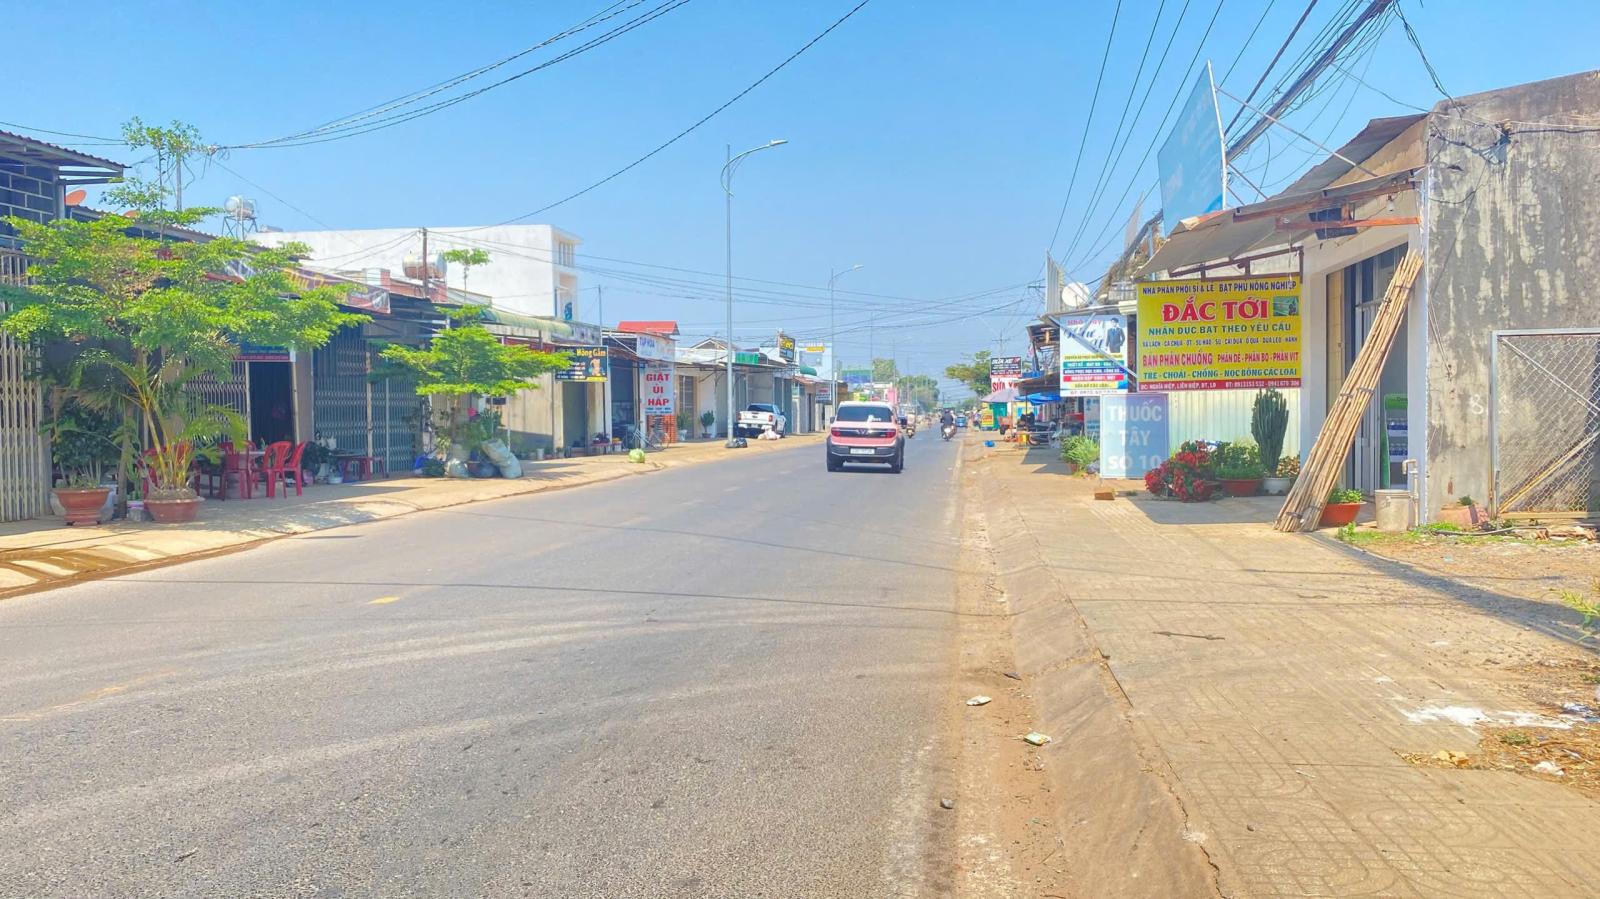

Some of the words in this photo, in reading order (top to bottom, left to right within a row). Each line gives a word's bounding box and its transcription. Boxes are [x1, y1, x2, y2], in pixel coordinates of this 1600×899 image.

[1157, 284, 1174, 294] PHÂN
[1219, 284, 1232, 294] BẠT
[1234, 280, 1248, 291] PHỦ
[1250, 280, 1268, 290] NÔNG
[1162, 296, 1216, 322] ĐẮC
[1222, 296, 1268, 320] TỚI
[1222, 324, 1247, 333] THEO
[1250, 322, 1268, 332] YÊU
[1160, 352, 1180, 366] PHÂN
[646, 372, 670, 383] GIẶT
[652, 383, 664, 394] ỦI
[1108, 400, 1162, 422] THUỐC
[1119, 426, 1151, 446] TÂY
[1140, 454, 1162, 470] 10
